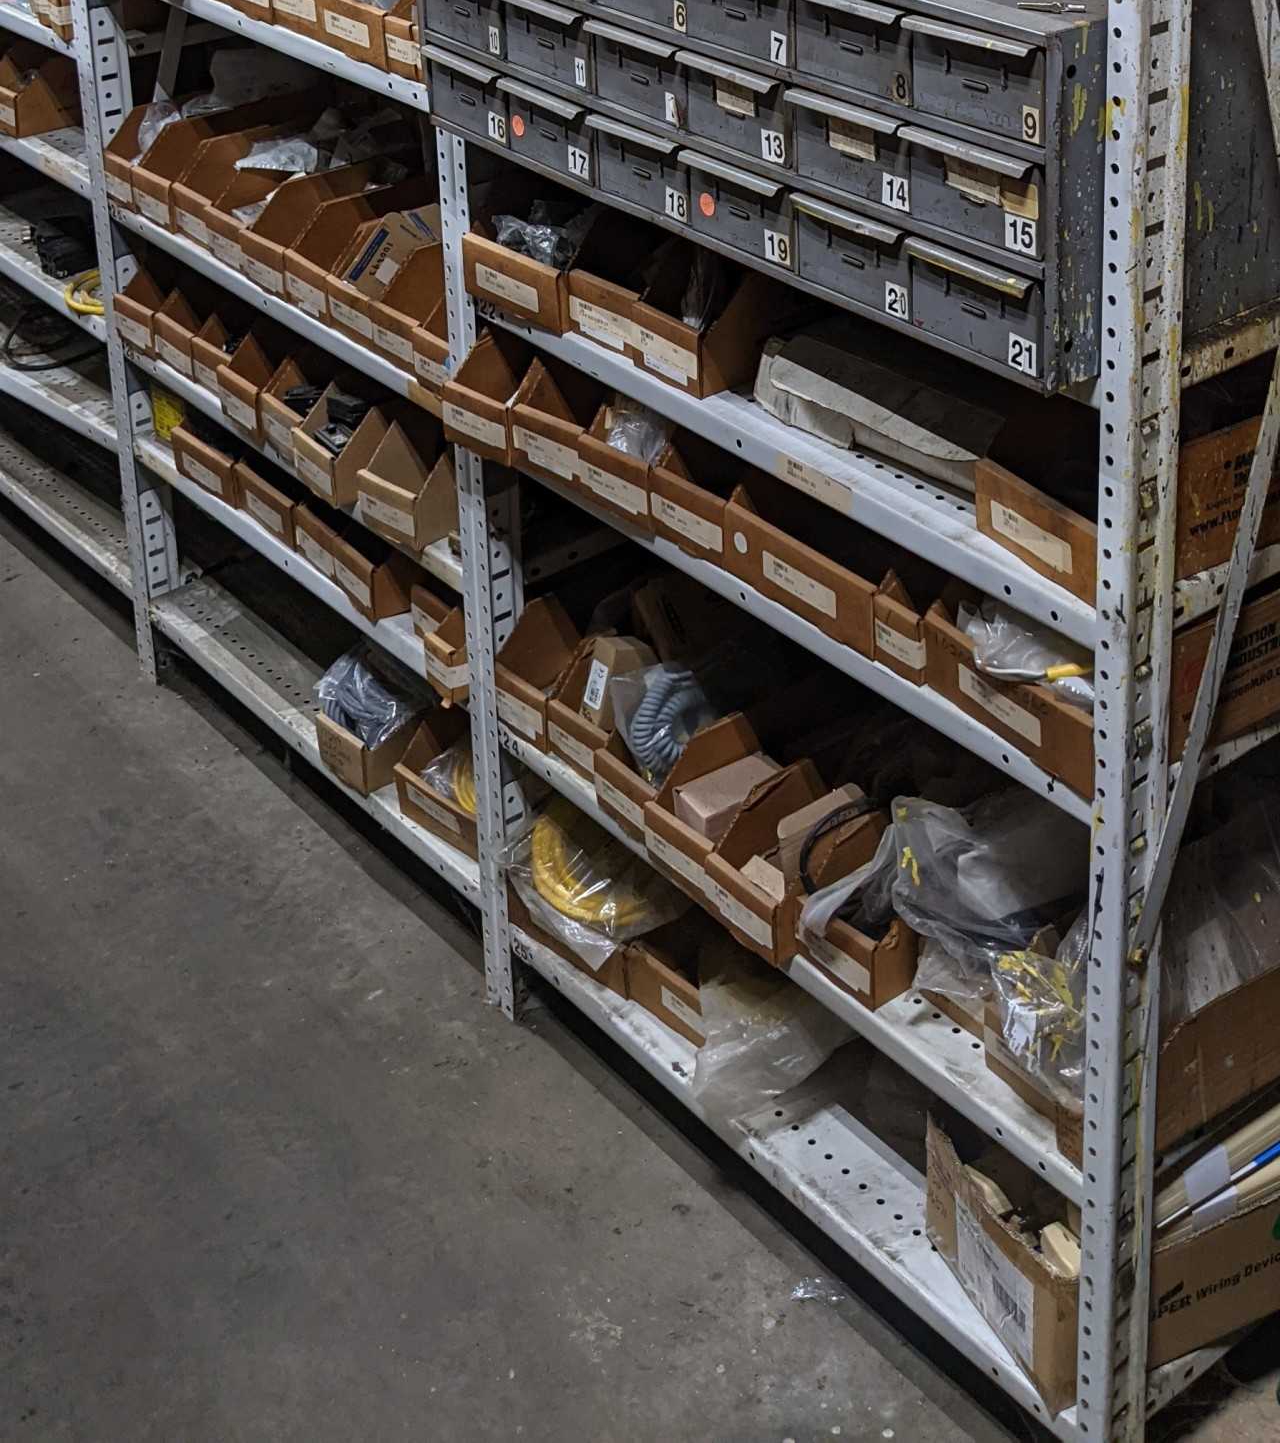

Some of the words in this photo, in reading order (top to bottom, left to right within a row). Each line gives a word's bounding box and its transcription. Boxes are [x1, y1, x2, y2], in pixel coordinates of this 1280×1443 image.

[675, 3, 685, 28] 6
[773, 36, 784, 60] 7
[576, 60, 585, 81] 11
[895, 73, 906, 100] 8
[491, 113, 505, 140] 16
[1024, 112, 1037, 139] 9
[764, 133, 783, 160] 13
[569, 148, 588, 175] 17
[668, 190, 686, 217] 18
[886, 177, 907, 206] 14
[1009, 218, 1035, 249] 15
[768, 234, 788, 262] 19
[887, 286, 907, 315] 20
[1010, 338, 1036, 370] 21
[503, 731, 520, 757] 24
[514, 937, 528, 960] 25
[1195, 1272, 1241, 1302] Wiring
